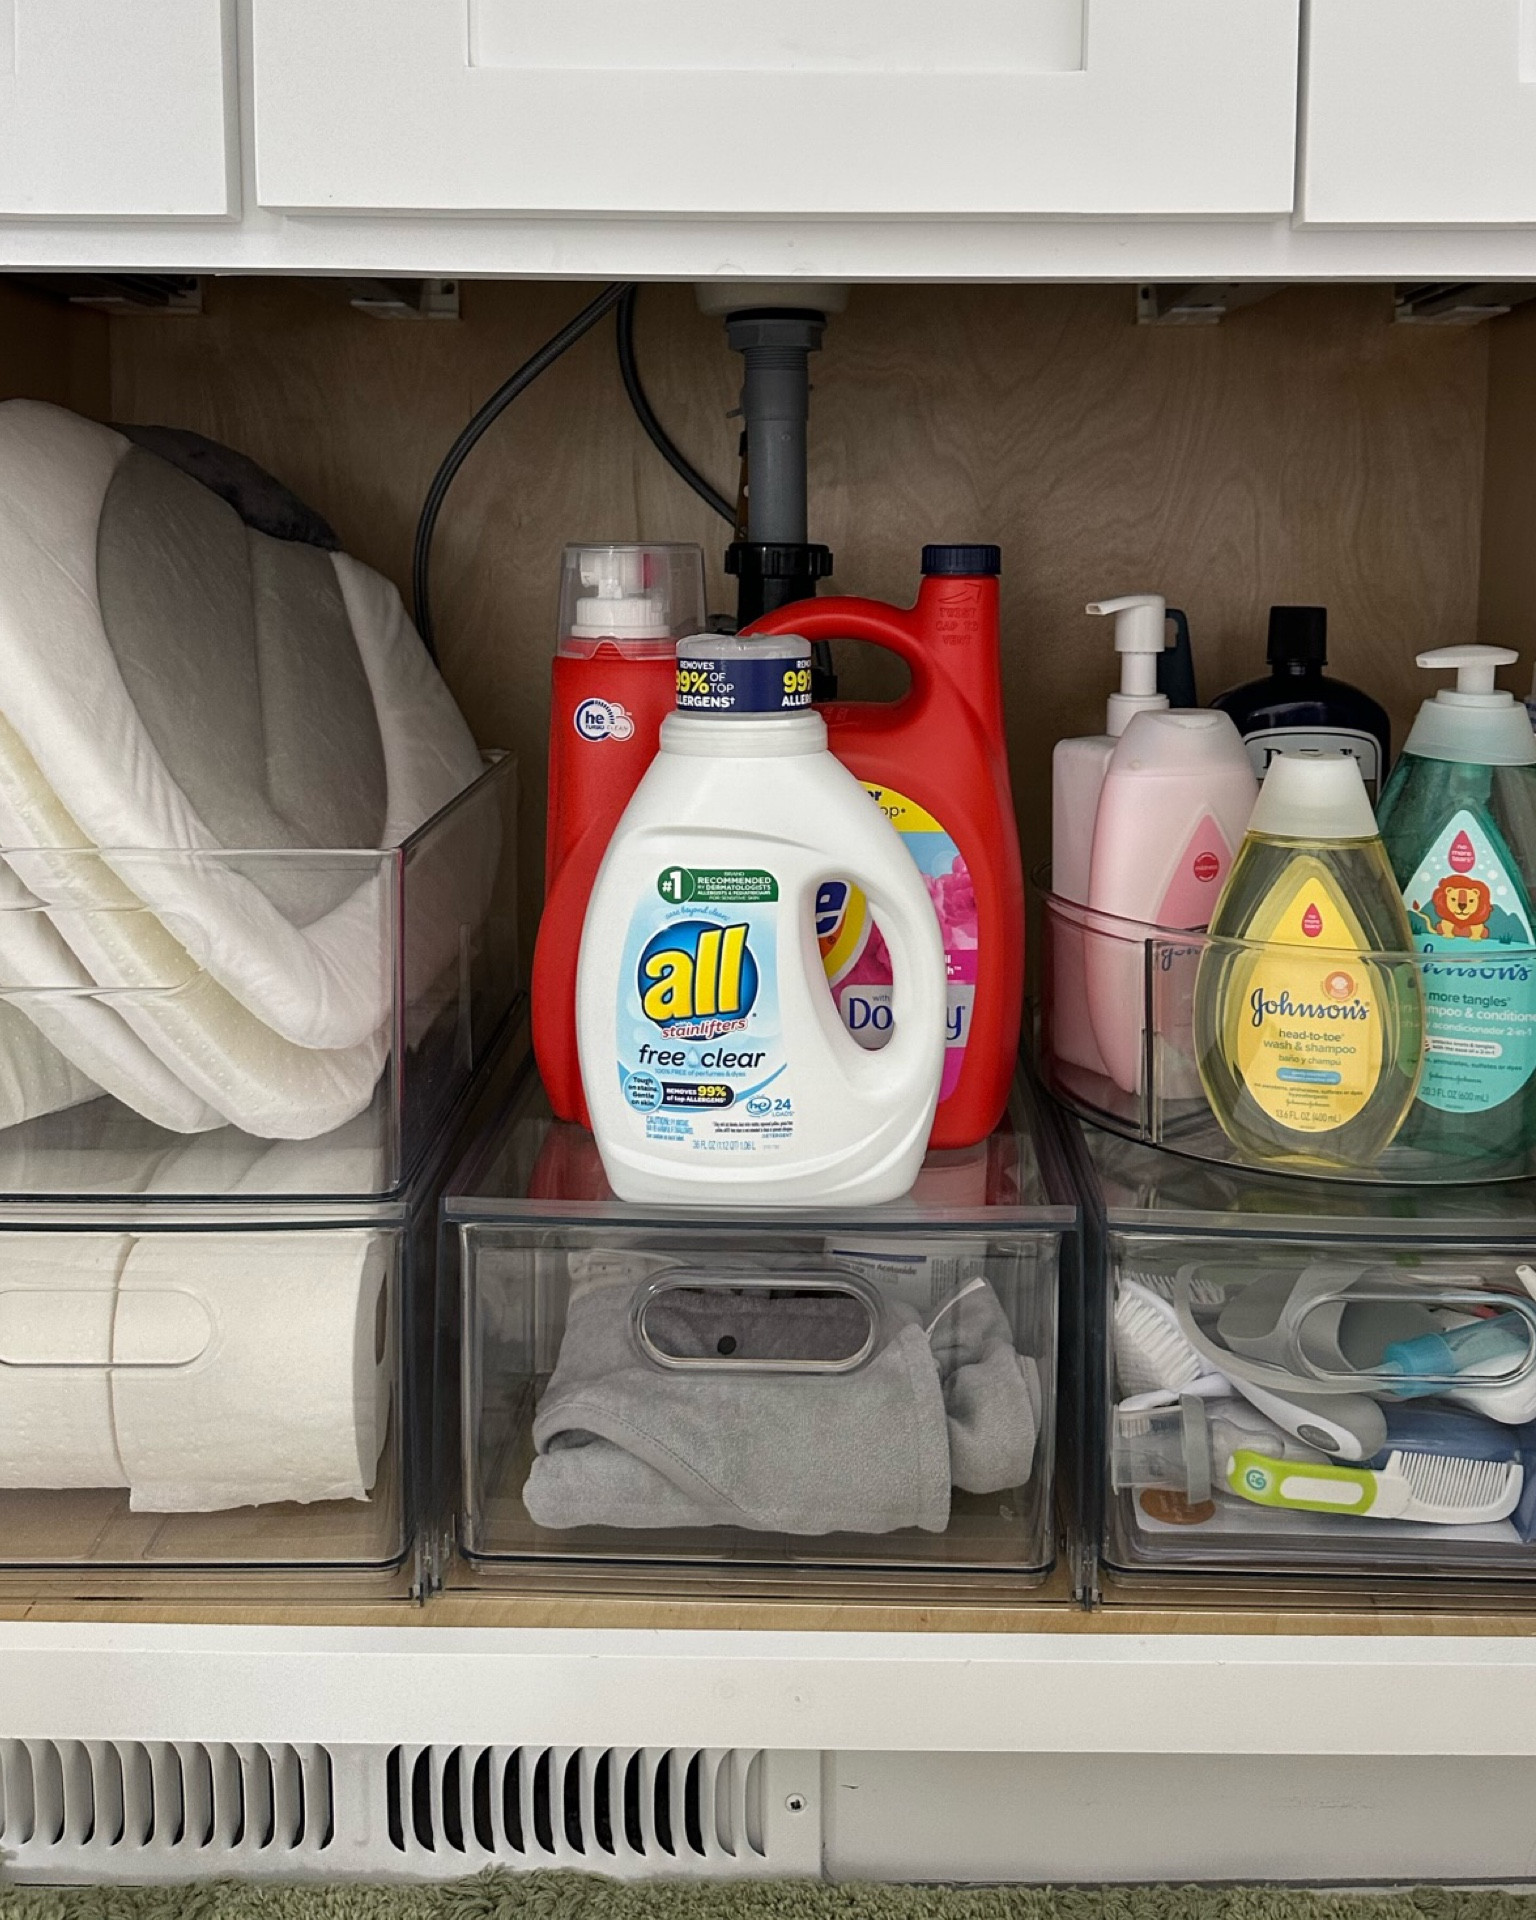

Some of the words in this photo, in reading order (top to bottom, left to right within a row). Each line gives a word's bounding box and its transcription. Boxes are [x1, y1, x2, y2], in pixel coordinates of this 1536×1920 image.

[709, 672, 727, 682] OF
[709, 683, 735, 694] TOP
[585, 711, 605, 725] he
[662, 870, 682, 900] #1
[697, 877, 772, 885] RECOMMENDED
[641, 922, 750, 1021] all
[1428, 991, 1461, 1004] more
[1250, 987, 1370, 1028] Johnson's
[1464, 1007, 1474, 1019] &
[662, 1019, 747, 1039] stainlifters
[1263, 1040, 1293, 1051] wash
[1294, 1041, 1303, 1051] &
[1305, 1042, 1357, 1056] shampoo
[639, 1043, 687, 1068] free
[700, 1047, 767, 1069] clear
[633, 1076, 654, 1086] Tough
[697, 1085, 726, 1097] 99%
[774, 1098, 792, 1110] 24
